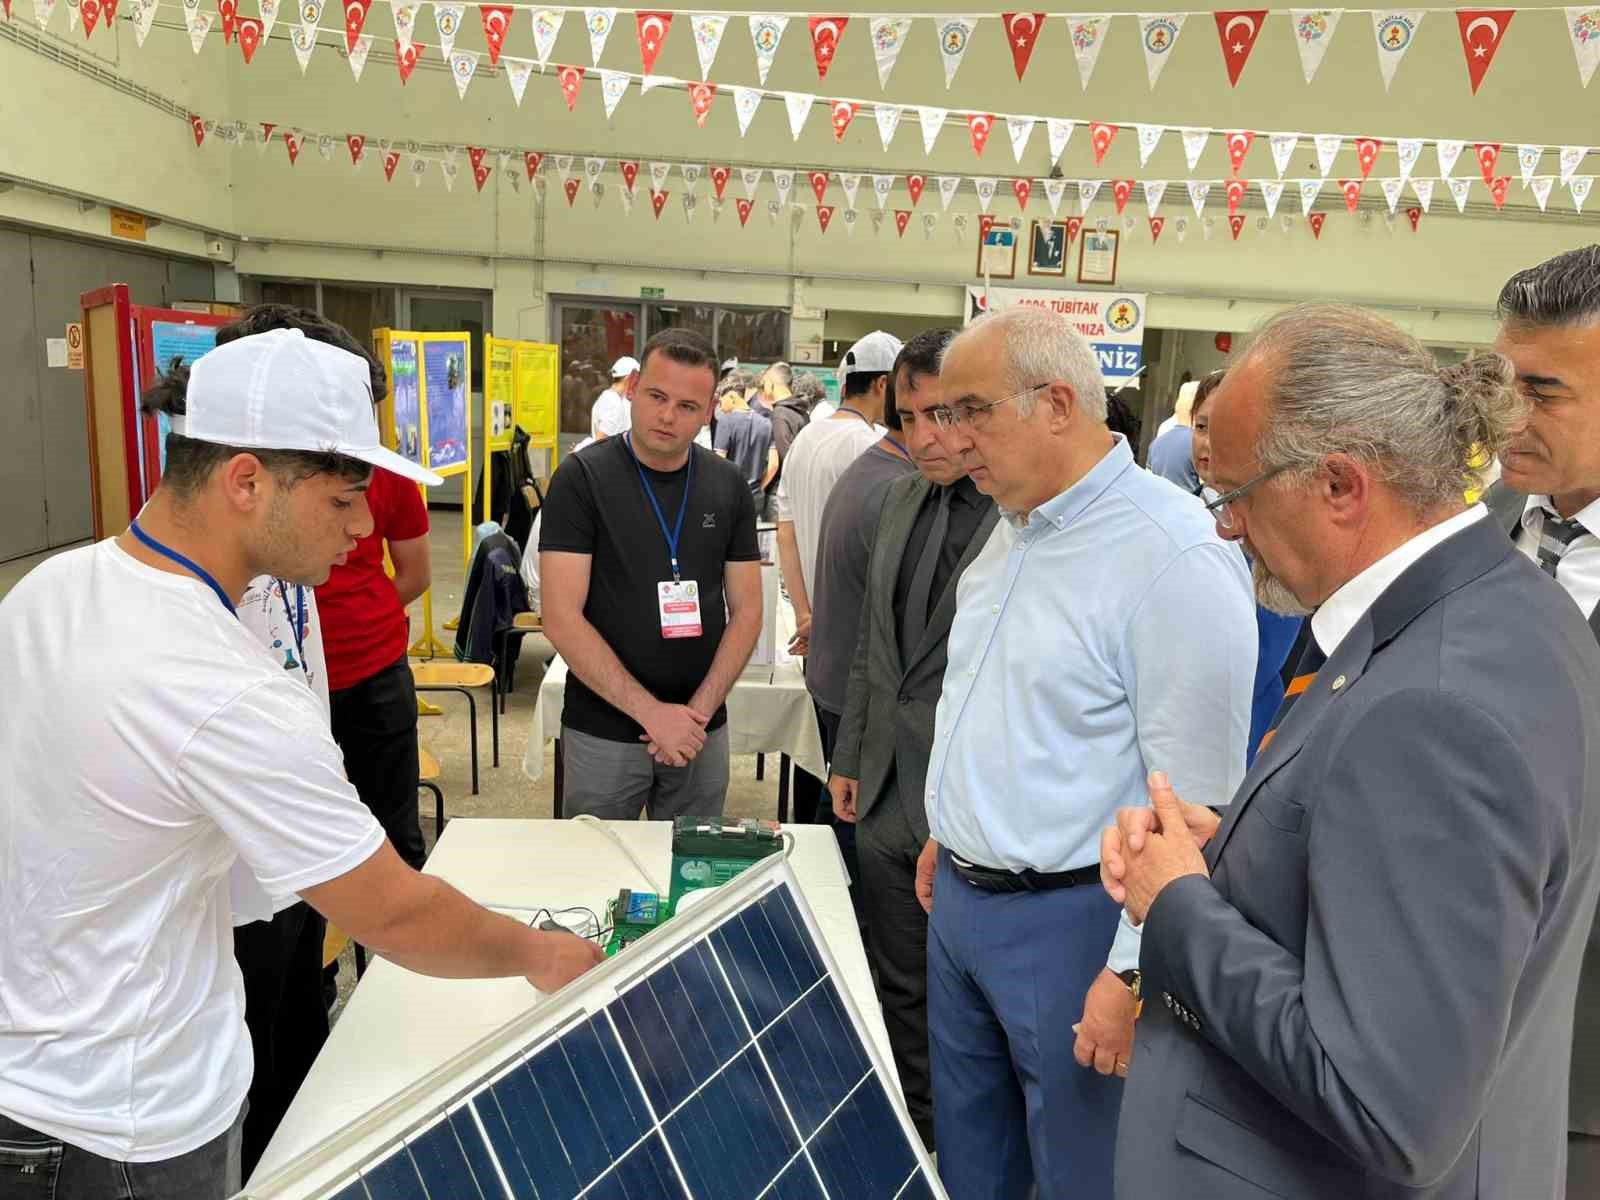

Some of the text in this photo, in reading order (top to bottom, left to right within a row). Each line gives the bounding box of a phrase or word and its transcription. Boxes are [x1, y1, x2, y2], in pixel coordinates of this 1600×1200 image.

[1050, 297, 1099, 315] TÜBİTAK
[1072, 322, 1105, 336] MIZA
[1092, 345, 1138, 369] NİZ
